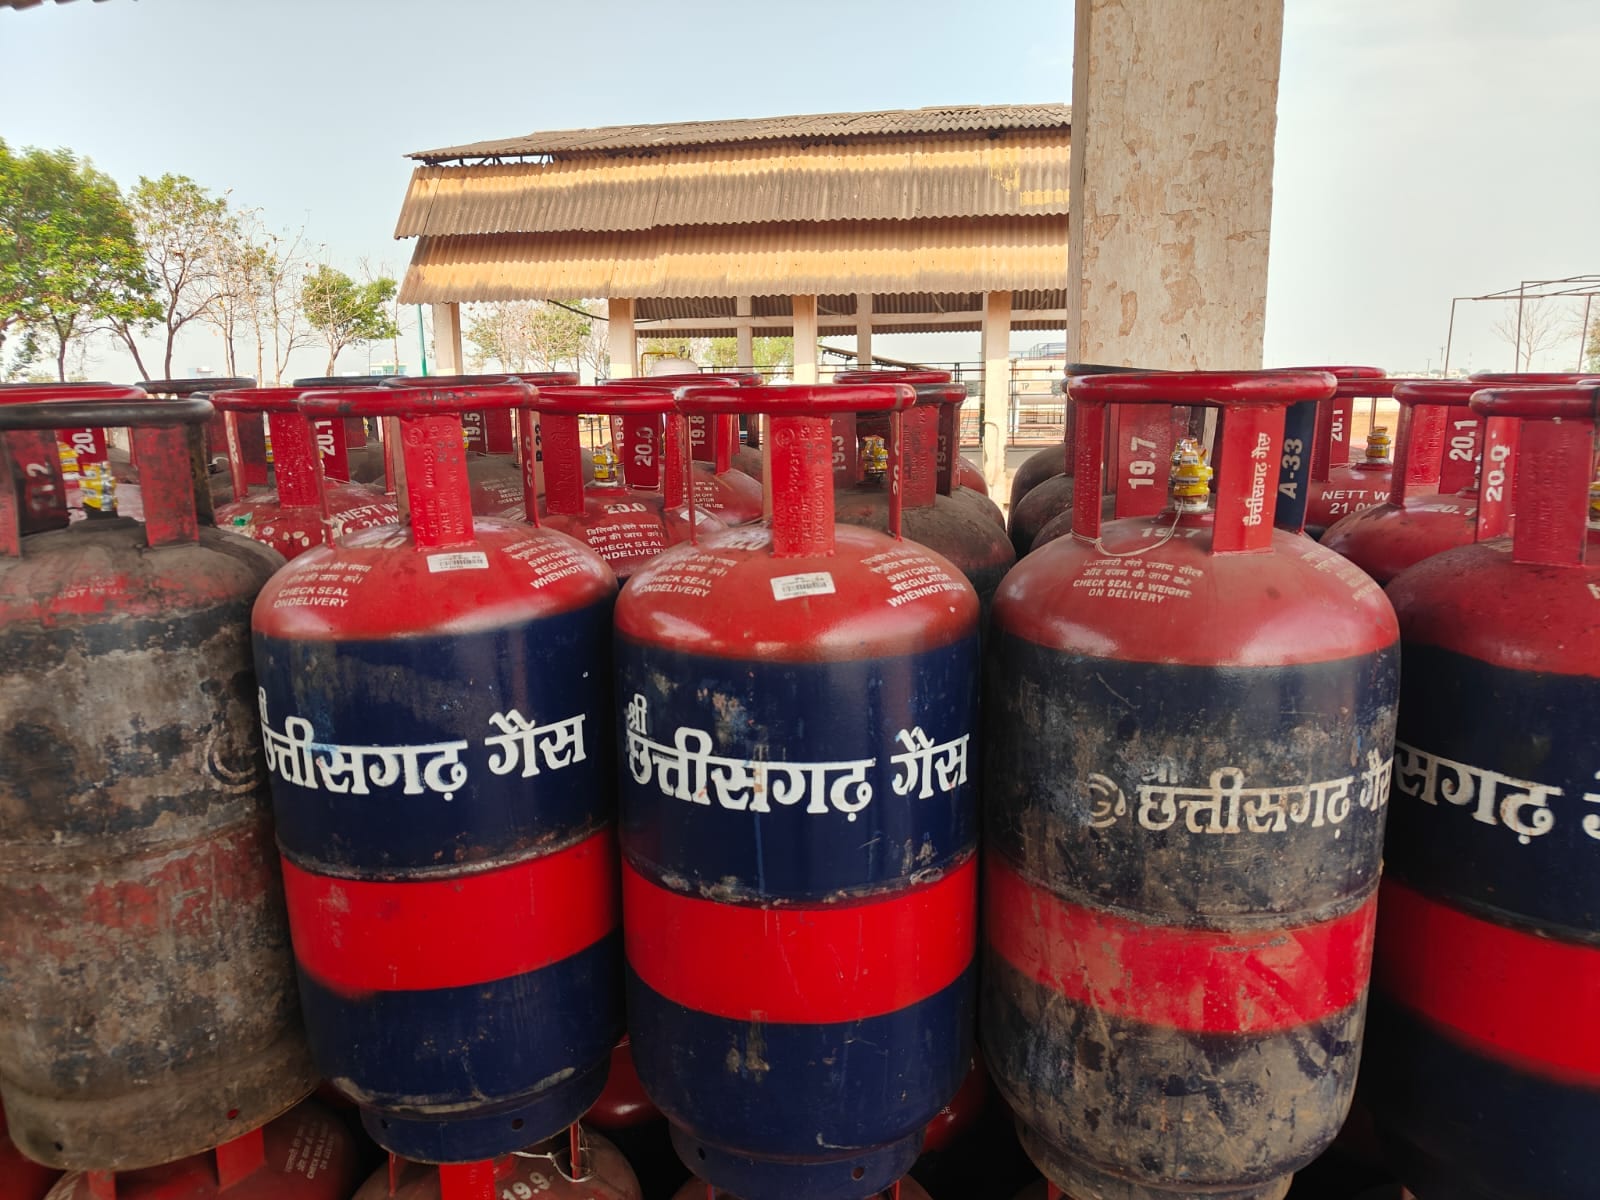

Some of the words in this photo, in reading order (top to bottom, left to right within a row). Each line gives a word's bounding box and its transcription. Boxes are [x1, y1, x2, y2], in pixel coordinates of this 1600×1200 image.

[72, 427, 97, 455] 20.
[1449, 420, 1478, 462] 20.1
[1128, 436, 1158, 490] 19.7
[1279, 438, 1303, 500] A-33
[1321, 490, 1369, 501] NETT
[1373, 491, 1391, 501] W
[634, 540, 665, 549] SEAL
[278, 586, 315, 598] CHECK
[316, 586, 349, 597] SEAL
[681, 575, 713, 588] SEAL
[891, 573, 952, 593] REGULATOR
[1072, 578, 1105, 588] CHECK
[1106, 578, 1134, 589] SEAL
[1135, 581, 1145, 591] &
[1088, 587, 1105, 598] ON
[1106, 587, 1166, 604] DELIVERY
[627, 692, 648, 736] श्री
[484, 708, 587, 778] गैस
[627, 725, 877, 822] छत्तीसगढ़
[890, 725, 971, 800] गैस
[1135, 766, 1355, 840] छत्तीसगढ़
[1396, 740, 1564, 846] सगढ़
